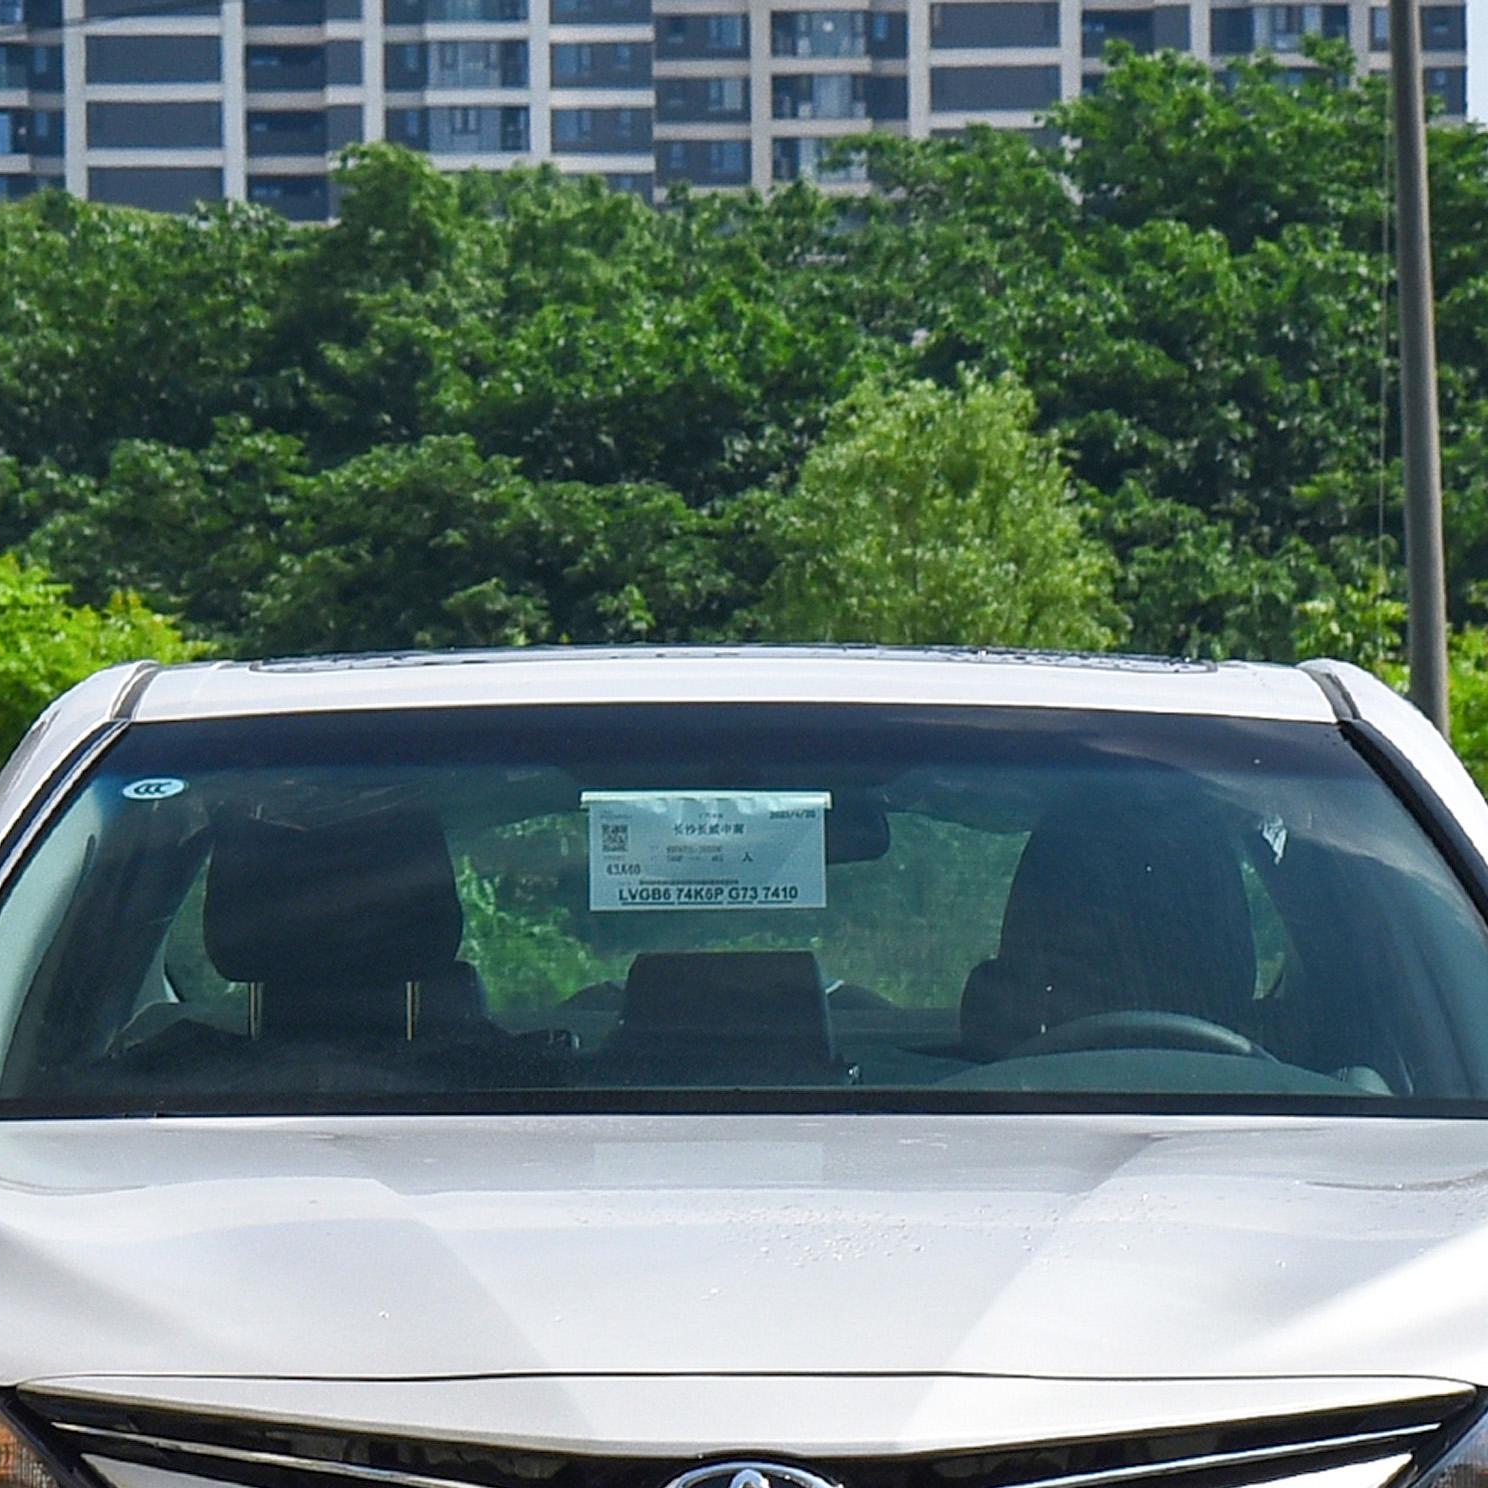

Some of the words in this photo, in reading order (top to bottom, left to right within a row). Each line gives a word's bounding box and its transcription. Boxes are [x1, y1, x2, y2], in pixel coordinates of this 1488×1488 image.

[618, 887, 672, 901] LVGB6
[676, 887, 725, 901] 74K6P
[728, 886, 759, 900] G73
[762, 886, 799, 899] 7410
